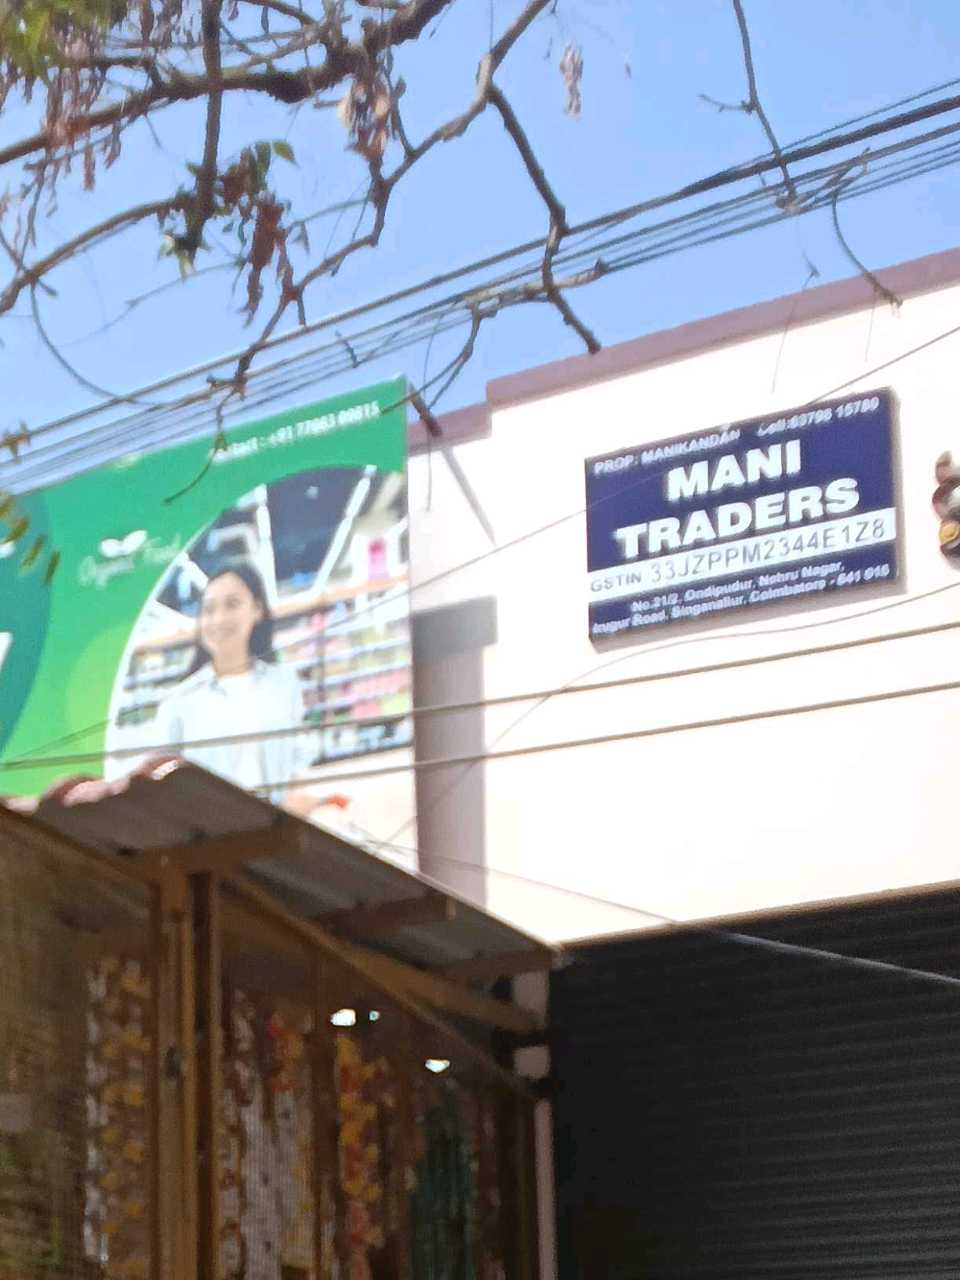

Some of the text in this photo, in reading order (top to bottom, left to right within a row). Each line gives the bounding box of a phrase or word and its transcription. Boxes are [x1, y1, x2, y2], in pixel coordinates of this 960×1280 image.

[641, 428, 741, 465] MANIKANDAN
[667, 438, 802, 501] MANI
[614, 476, 860, 559] TRADERS
[590, 518, 886, 592] GSTIN 33JZPPM2344E1Z8
[749, 579, 827, 603] Coimbatore
